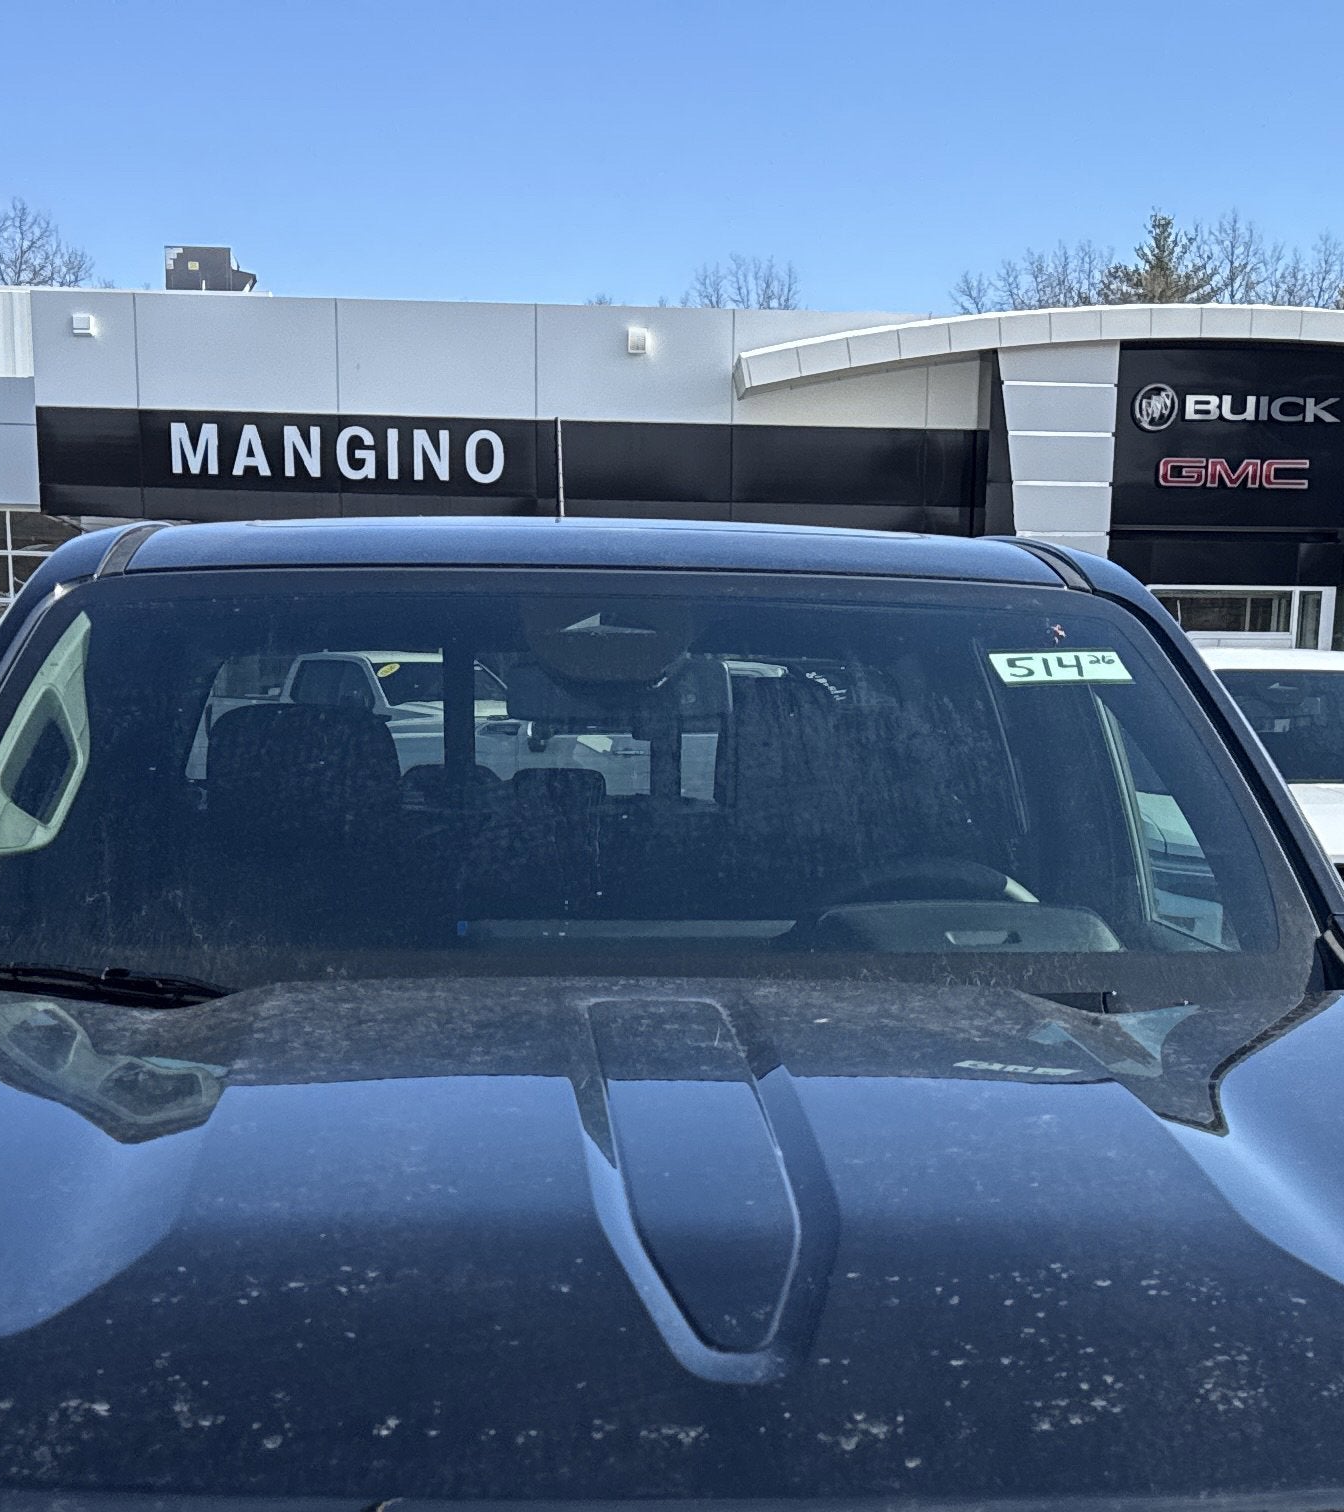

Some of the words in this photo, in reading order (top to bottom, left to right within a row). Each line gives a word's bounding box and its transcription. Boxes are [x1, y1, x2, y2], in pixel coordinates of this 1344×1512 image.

[1184, 394, 1341, 423] BUICK
[170, 422, 505, 484] MANGINO
[1159, 457, 1309, 489] GMC
[1006, 655, 1084, 678] 514
[1087, 654, 1115, 665] 26
